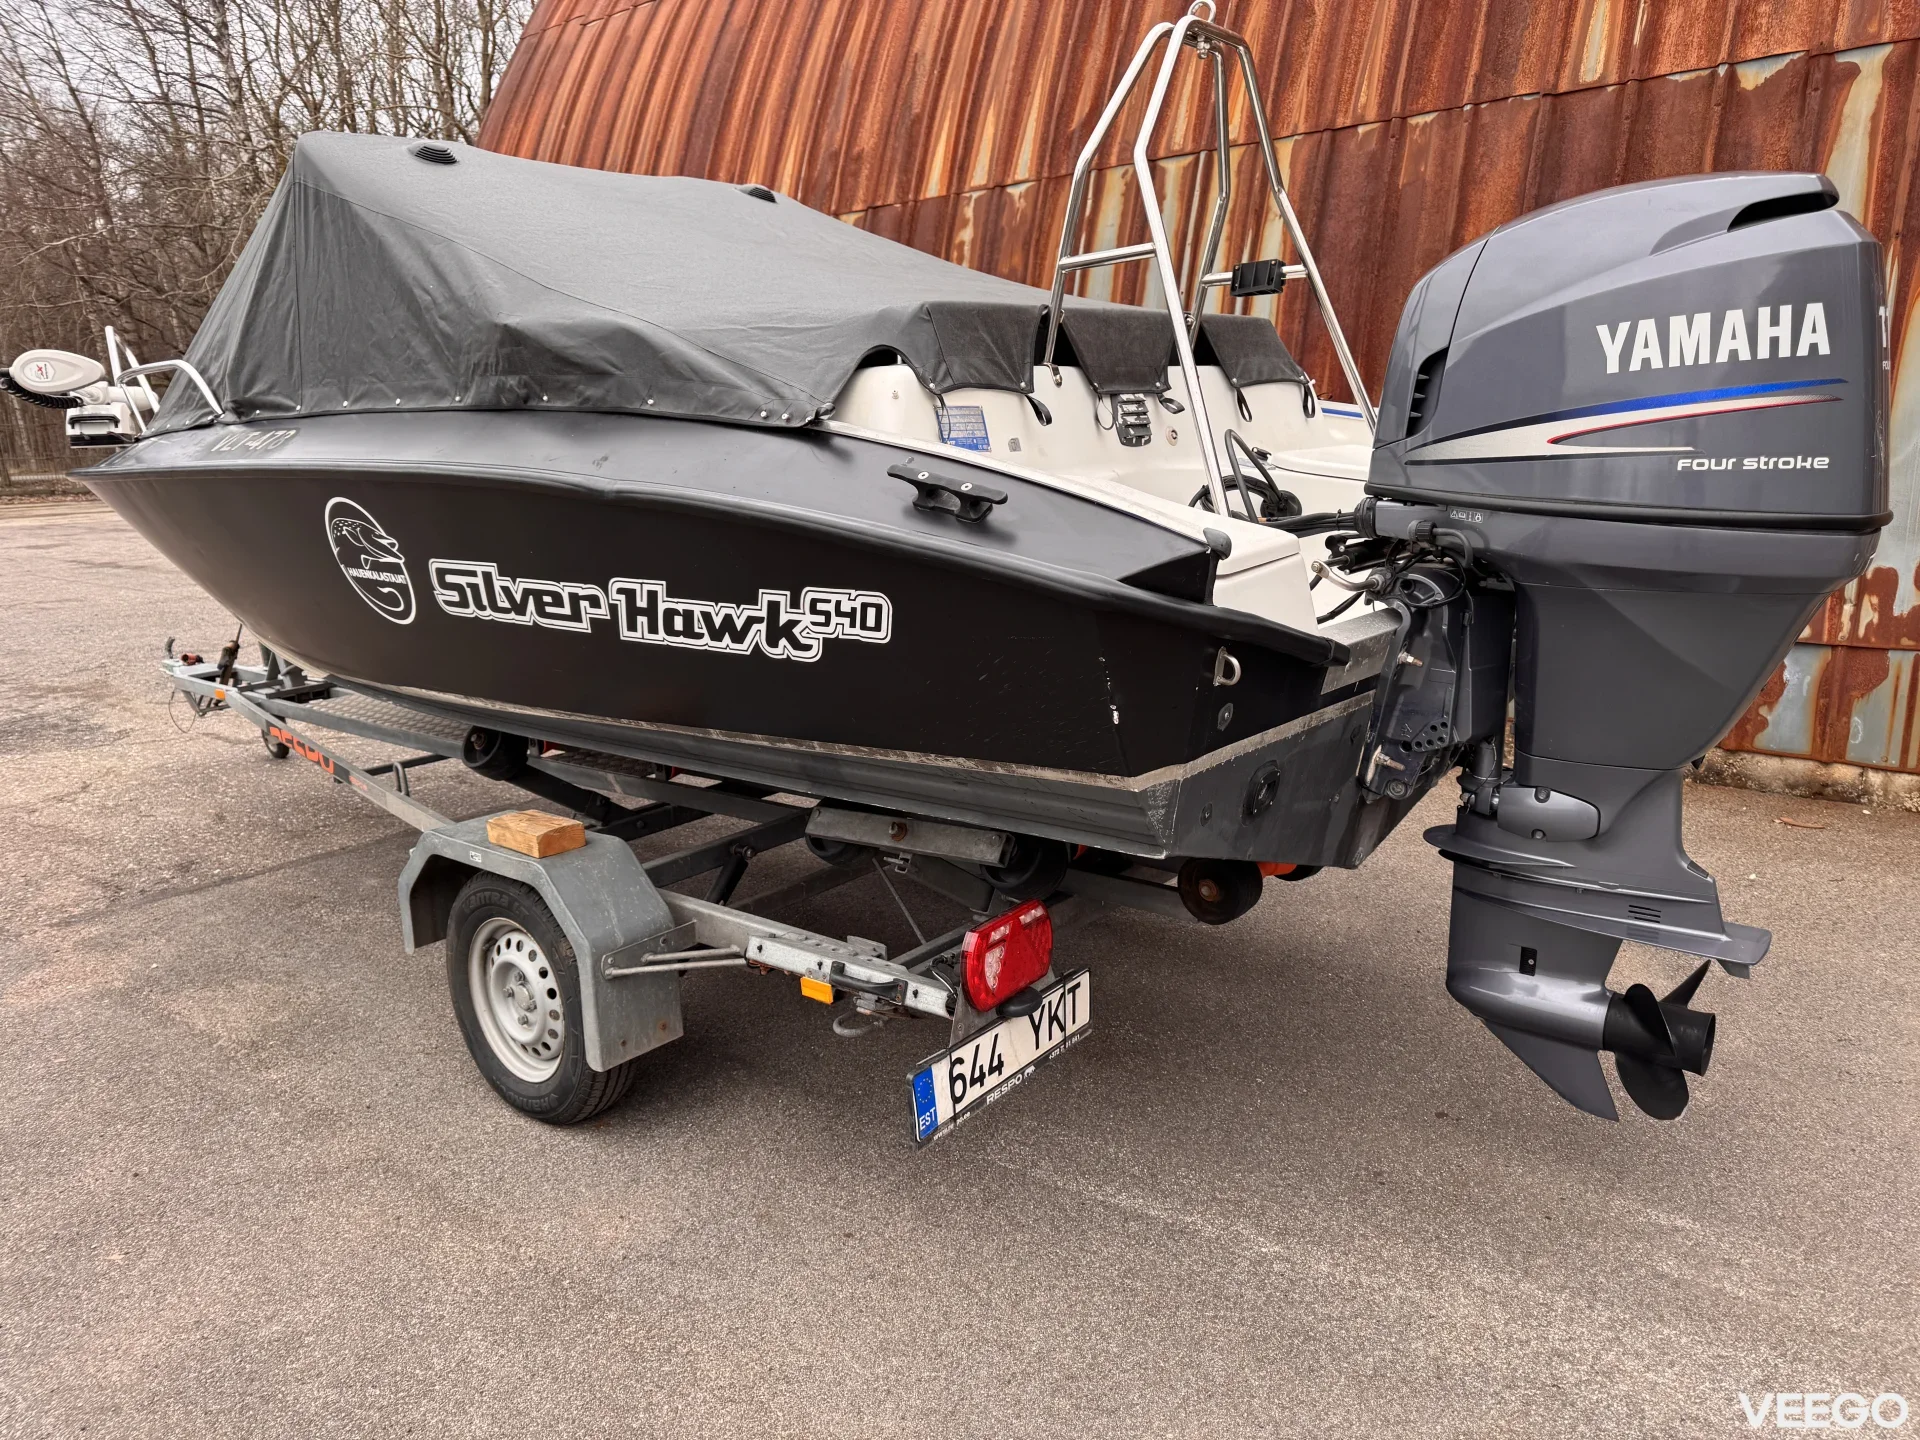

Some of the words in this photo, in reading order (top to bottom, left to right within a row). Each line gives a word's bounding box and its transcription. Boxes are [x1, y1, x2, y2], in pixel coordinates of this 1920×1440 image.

[1596, 302, 1831, 374] YAMAHA
[1677, 458, 1737, 471] Four
[1742, 455, 1830, 470] stroke
[428, 558, 610, 633] Silver
[609, 577, 823, 663] Hawk
[803, 586, 893, 644] 540
[950, 1032, 1005, 1104] 644
[1027, 981, 1081, 1051] YKT
[986, 1073, 1023, 1105] RESPO
[919, 1106, 936, 1131] EST
